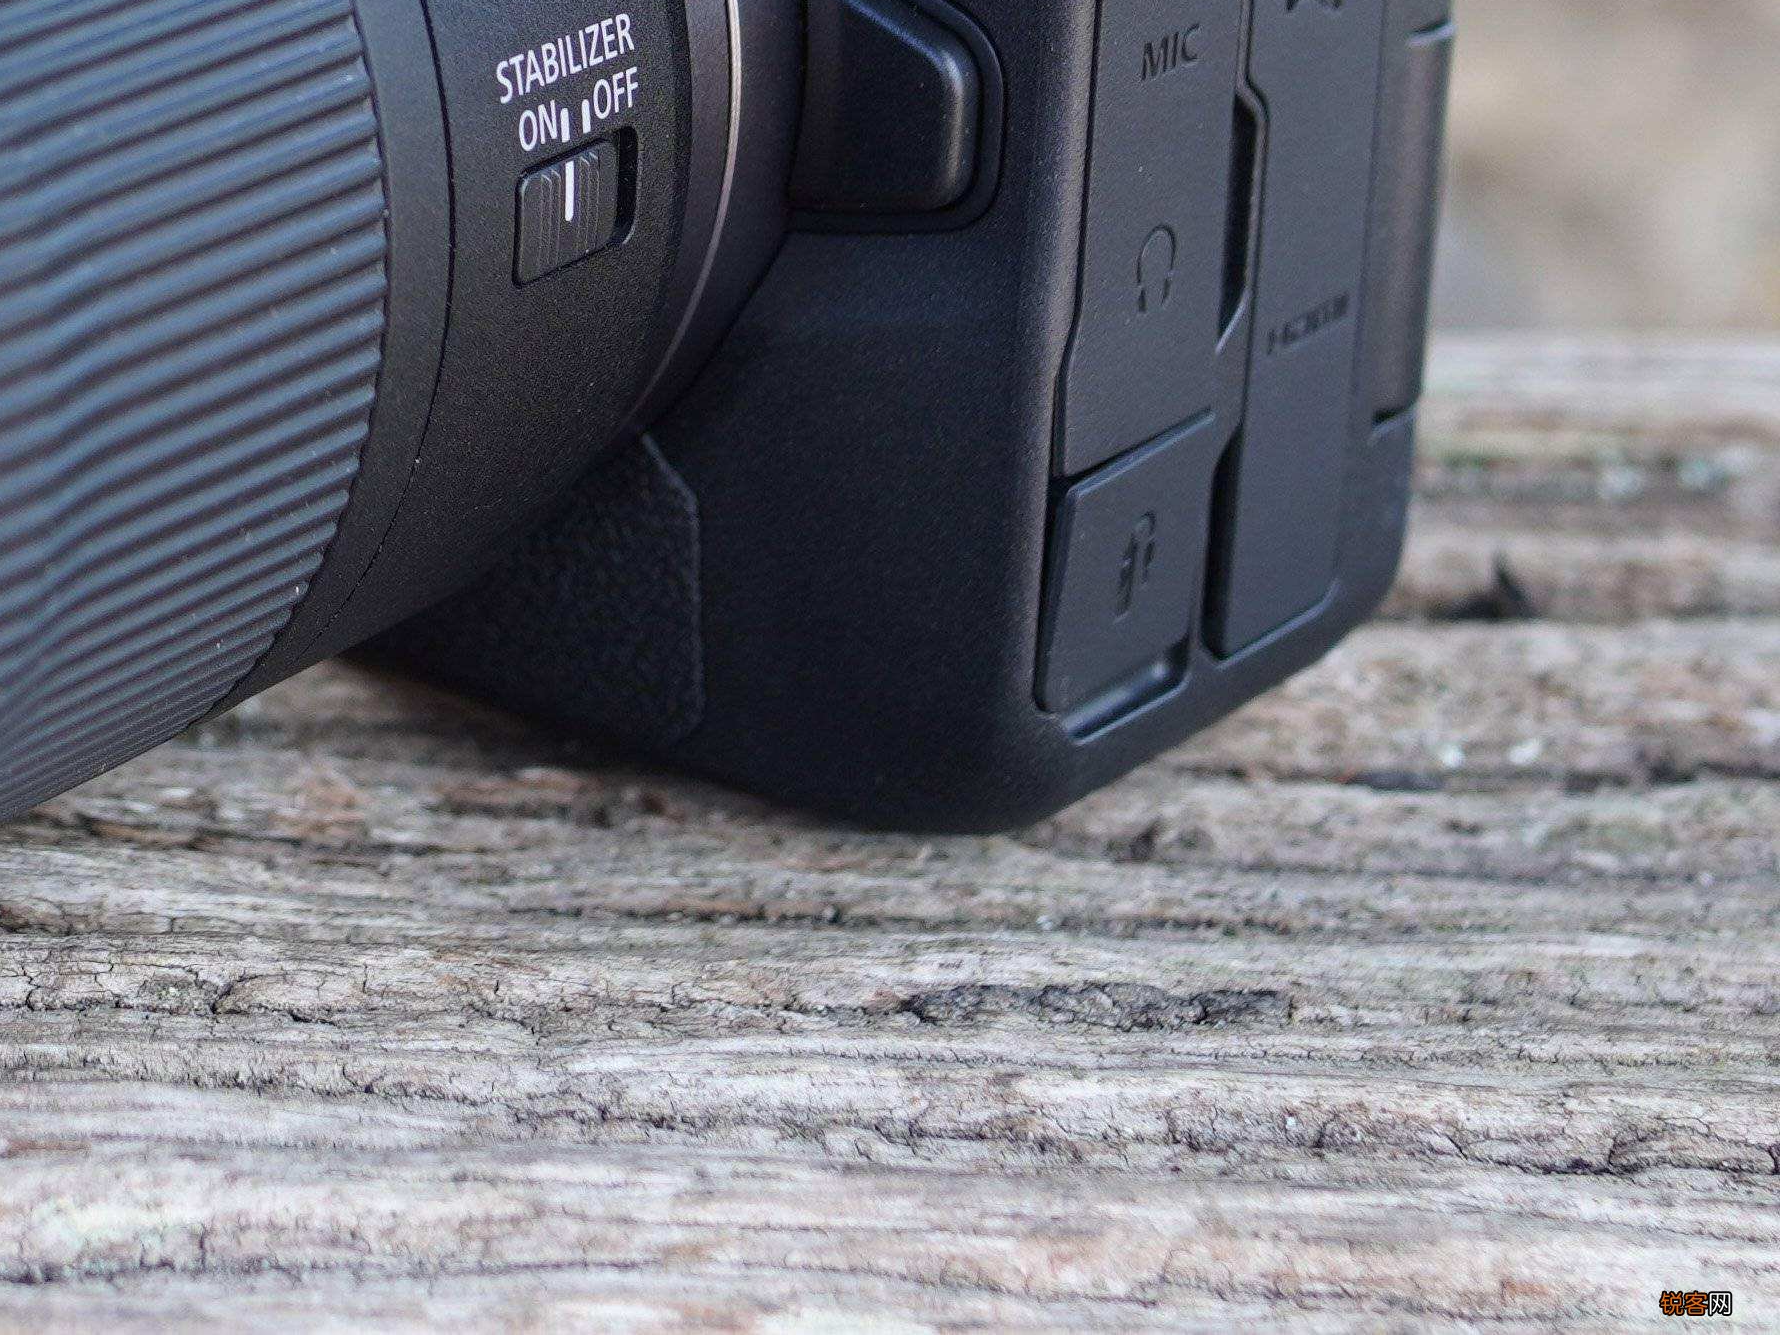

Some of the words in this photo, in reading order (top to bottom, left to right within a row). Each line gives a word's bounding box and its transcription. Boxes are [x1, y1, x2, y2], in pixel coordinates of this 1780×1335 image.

[495, 12, 635, 104] STABILIZER
[1141, 22, 1201, 81] MIC
[518, 99, 558, 152] ON
[592, 66, 639, 120] OFF
